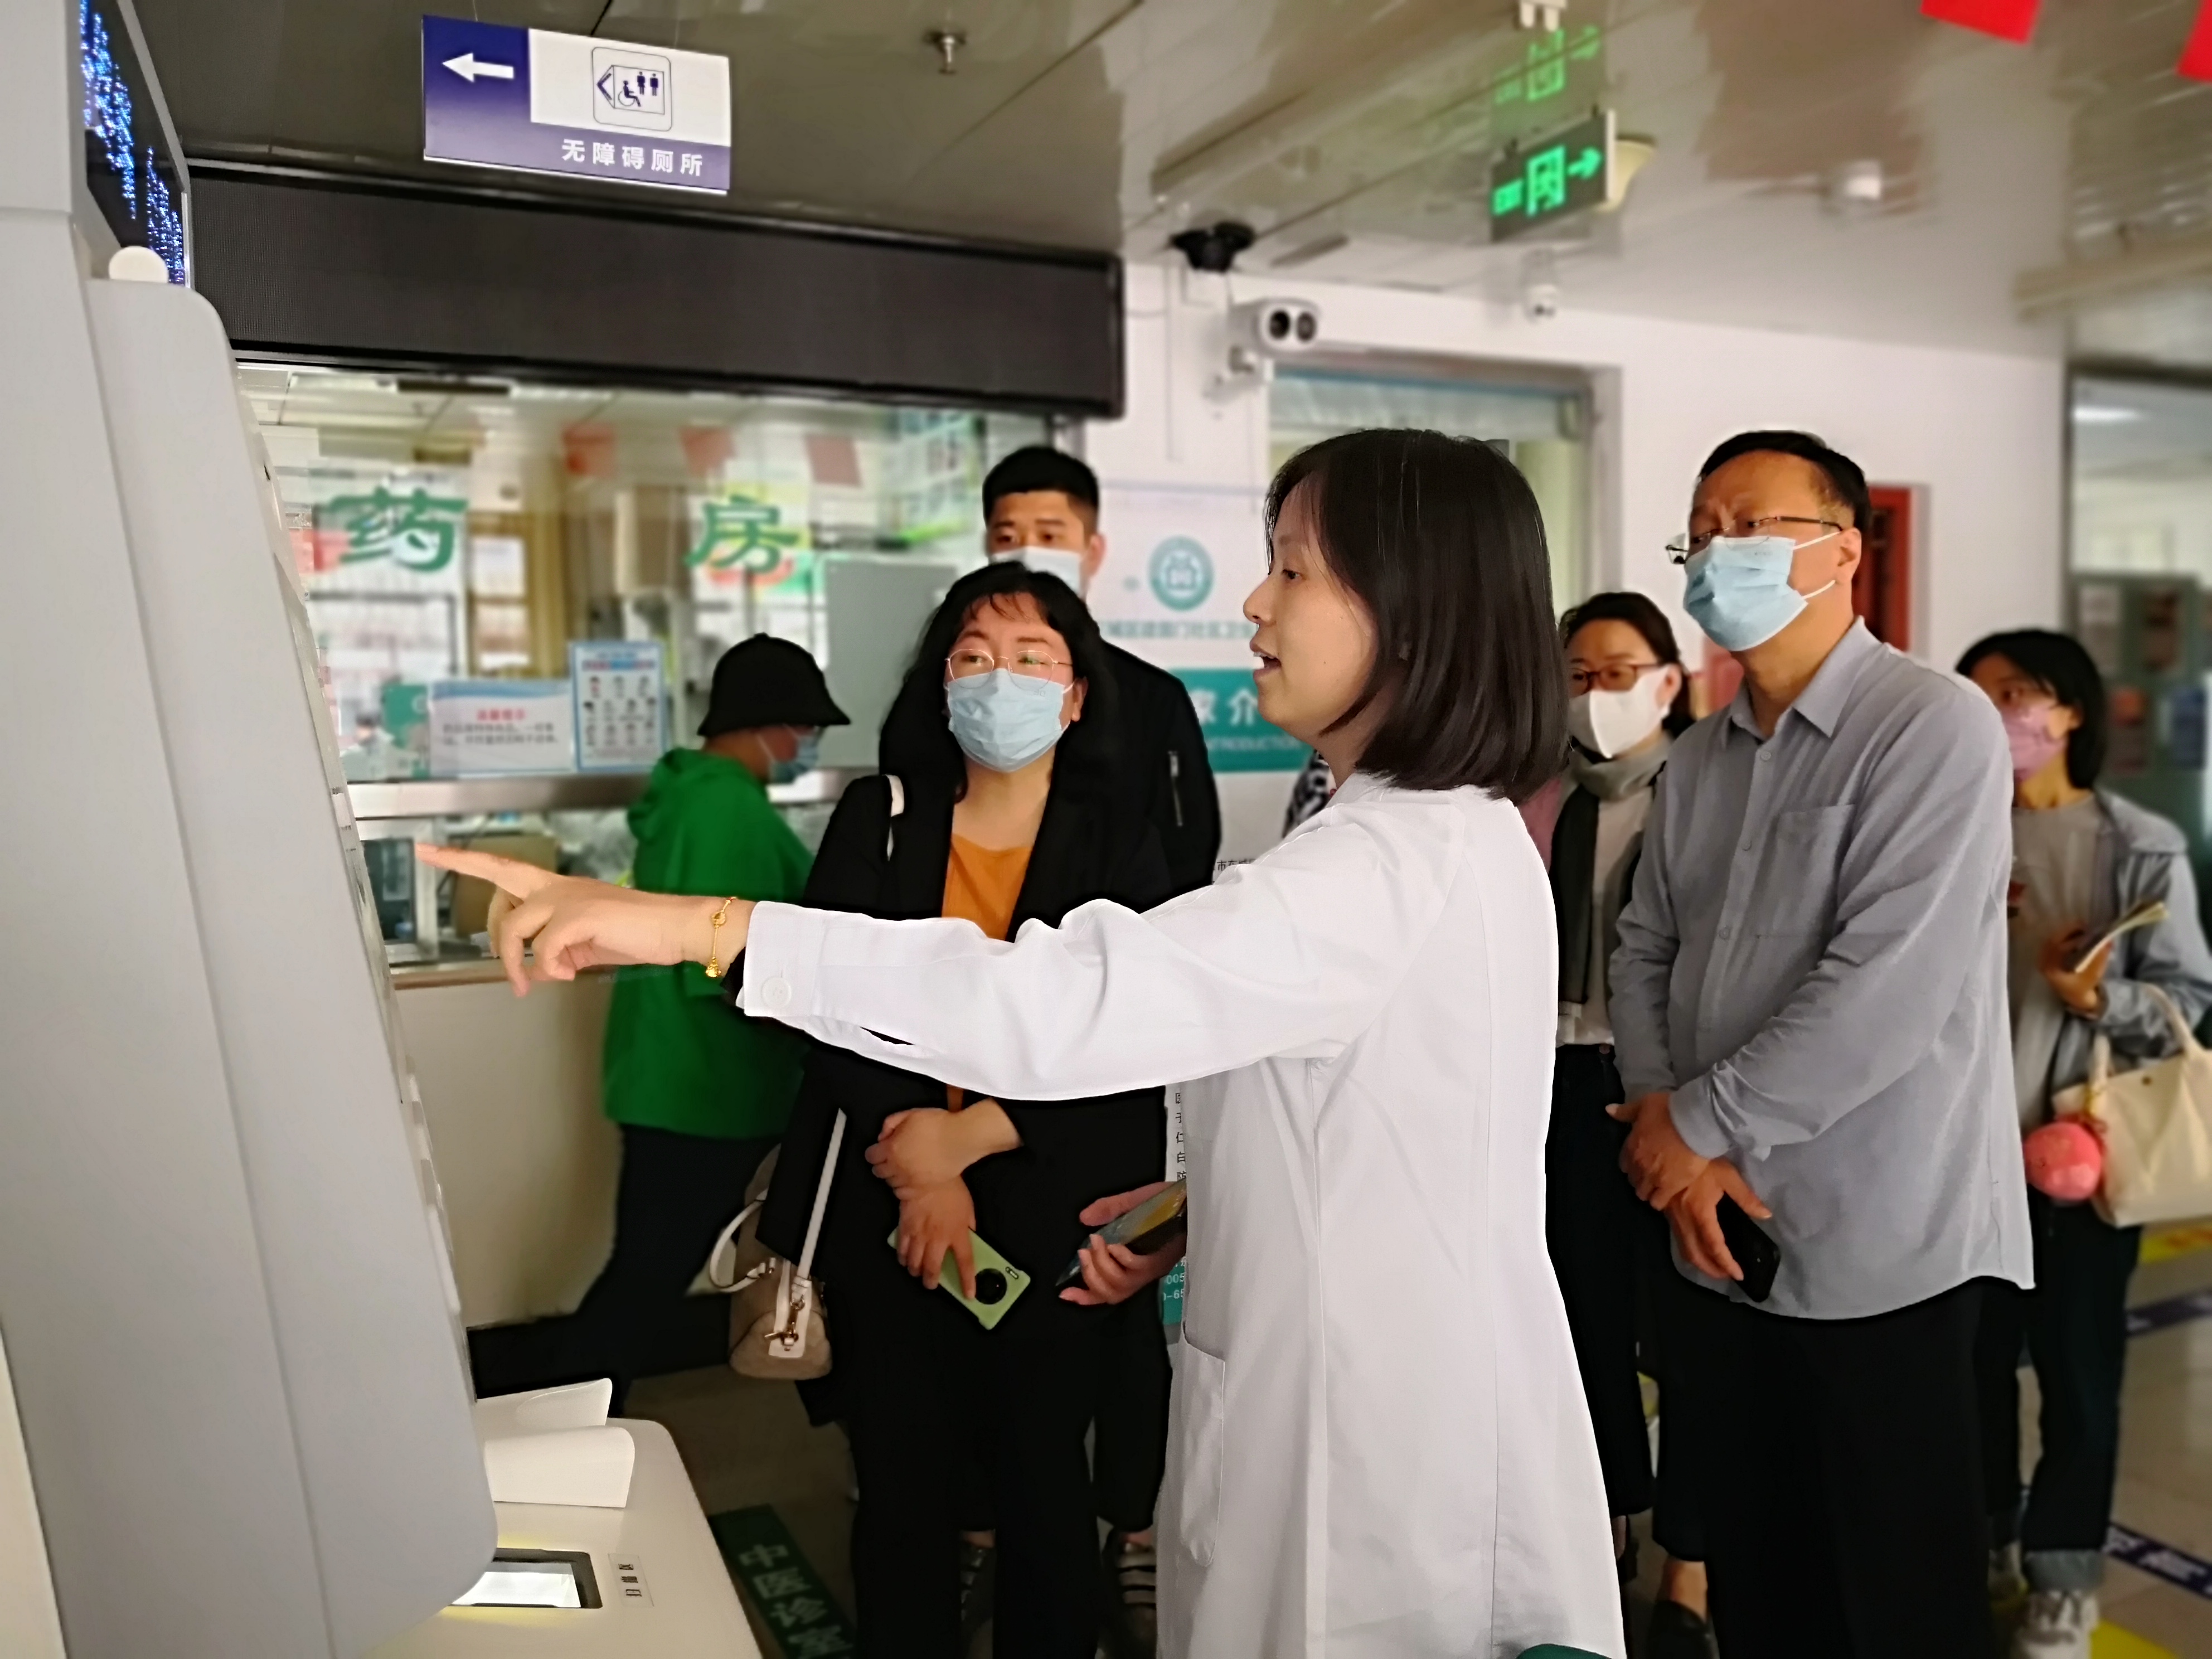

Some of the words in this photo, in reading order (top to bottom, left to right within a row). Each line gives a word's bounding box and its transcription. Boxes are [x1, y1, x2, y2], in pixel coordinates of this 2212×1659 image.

[561, 138, 703, 177] 无障碍厕所
[323, 486, 798, 574] 药房
